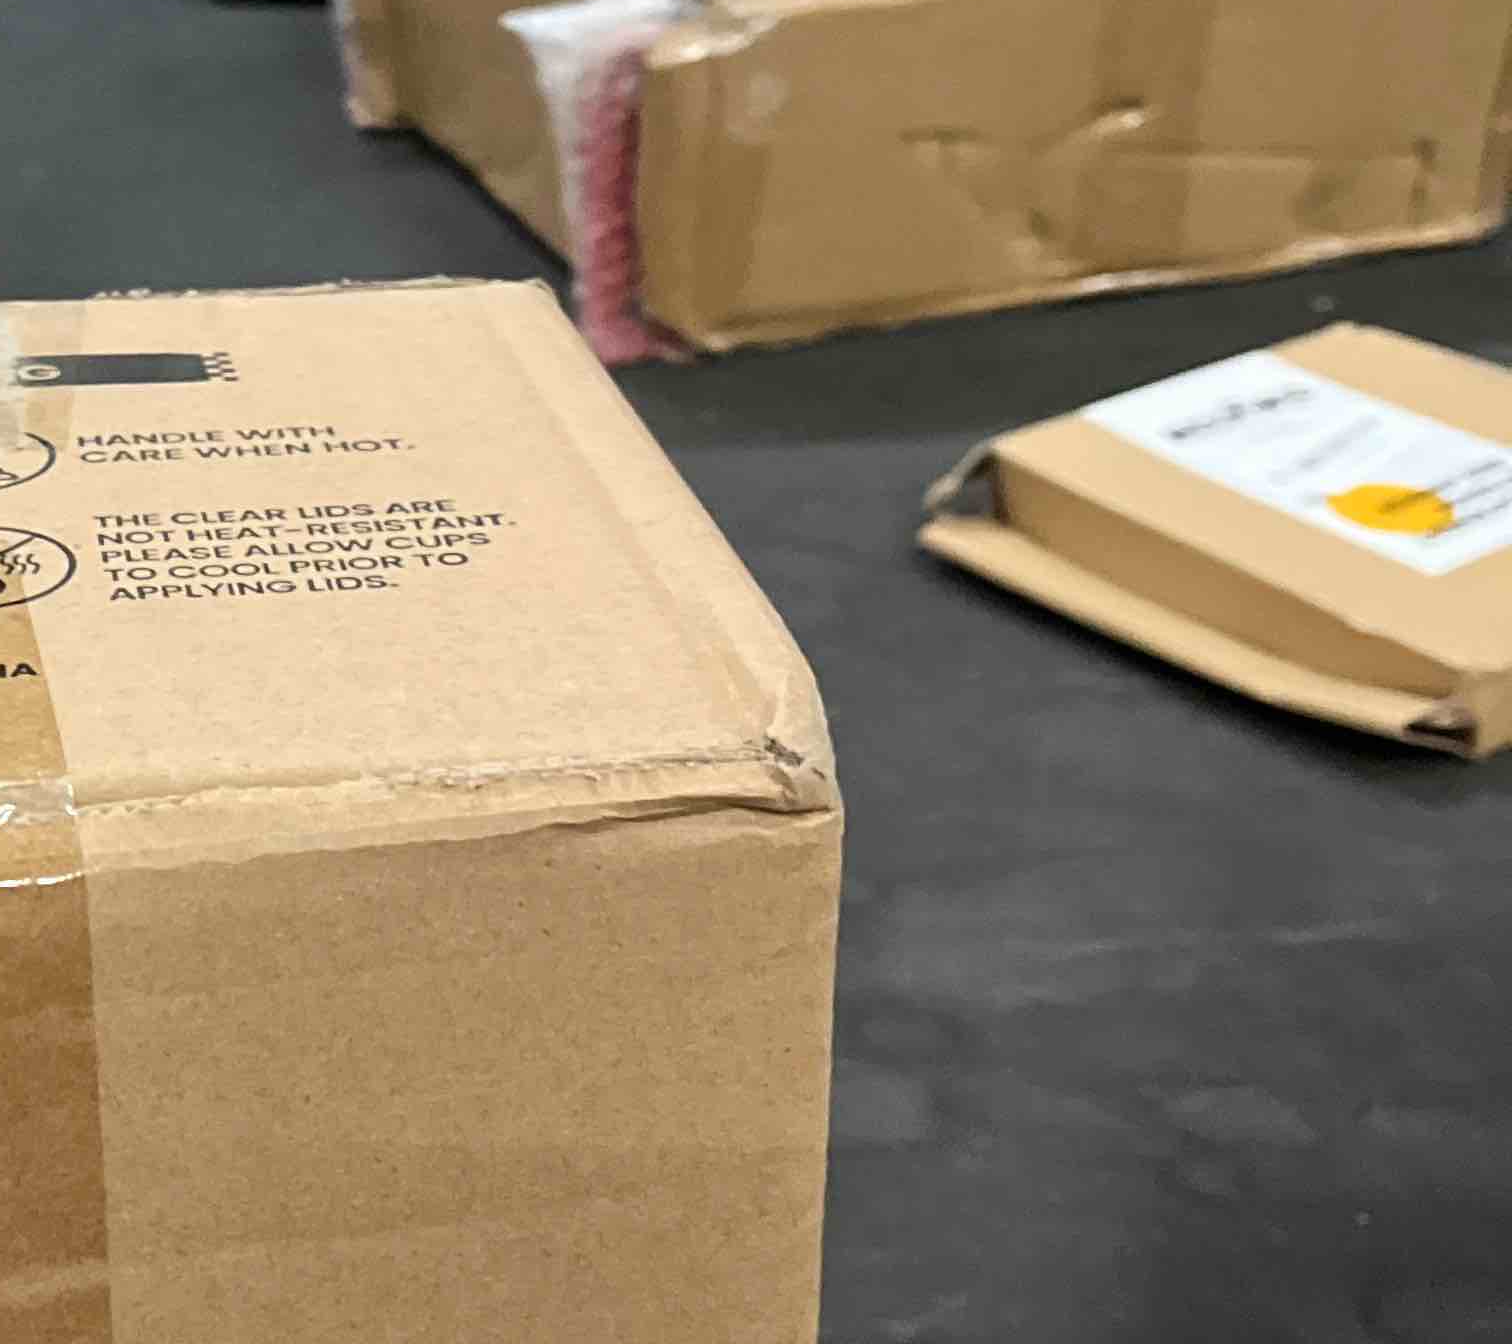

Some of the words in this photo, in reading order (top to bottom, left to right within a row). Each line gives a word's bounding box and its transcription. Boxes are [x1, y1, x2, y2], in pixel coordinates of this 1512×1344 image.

[77, 430, 225, 447] HANDLE
[235, 426, 336, 441] WITH
[80, 448, 185, 464] CARE
[195, 442, 311, 457] WHEN
[324, 438, 417, 453] HOT.
[94, 513, 161, 528] THE
[171, 508, 287, 525] CLEAR
[297, 503, 375, 519] LIDS
[386, 499, 457, 514] ARE
[97, 529, 175, 546] NOT
[186, 513, 517, 542] HEAT-RESISTANT.
[100, 545, 233, 564] PLEASE
[244, 538, 373, 557] ALLOW
[385, 532, 491, 550] CUPS
[104, 567, 157, 582] TO
[168, 562, 281, 580] COOL
[289, 555, 403, 574] PRIOR
[411, 552, 469, 567] TO
[110, 580, 297, 601] APPLYING
[307, 574, 400, 593] LIDS.
